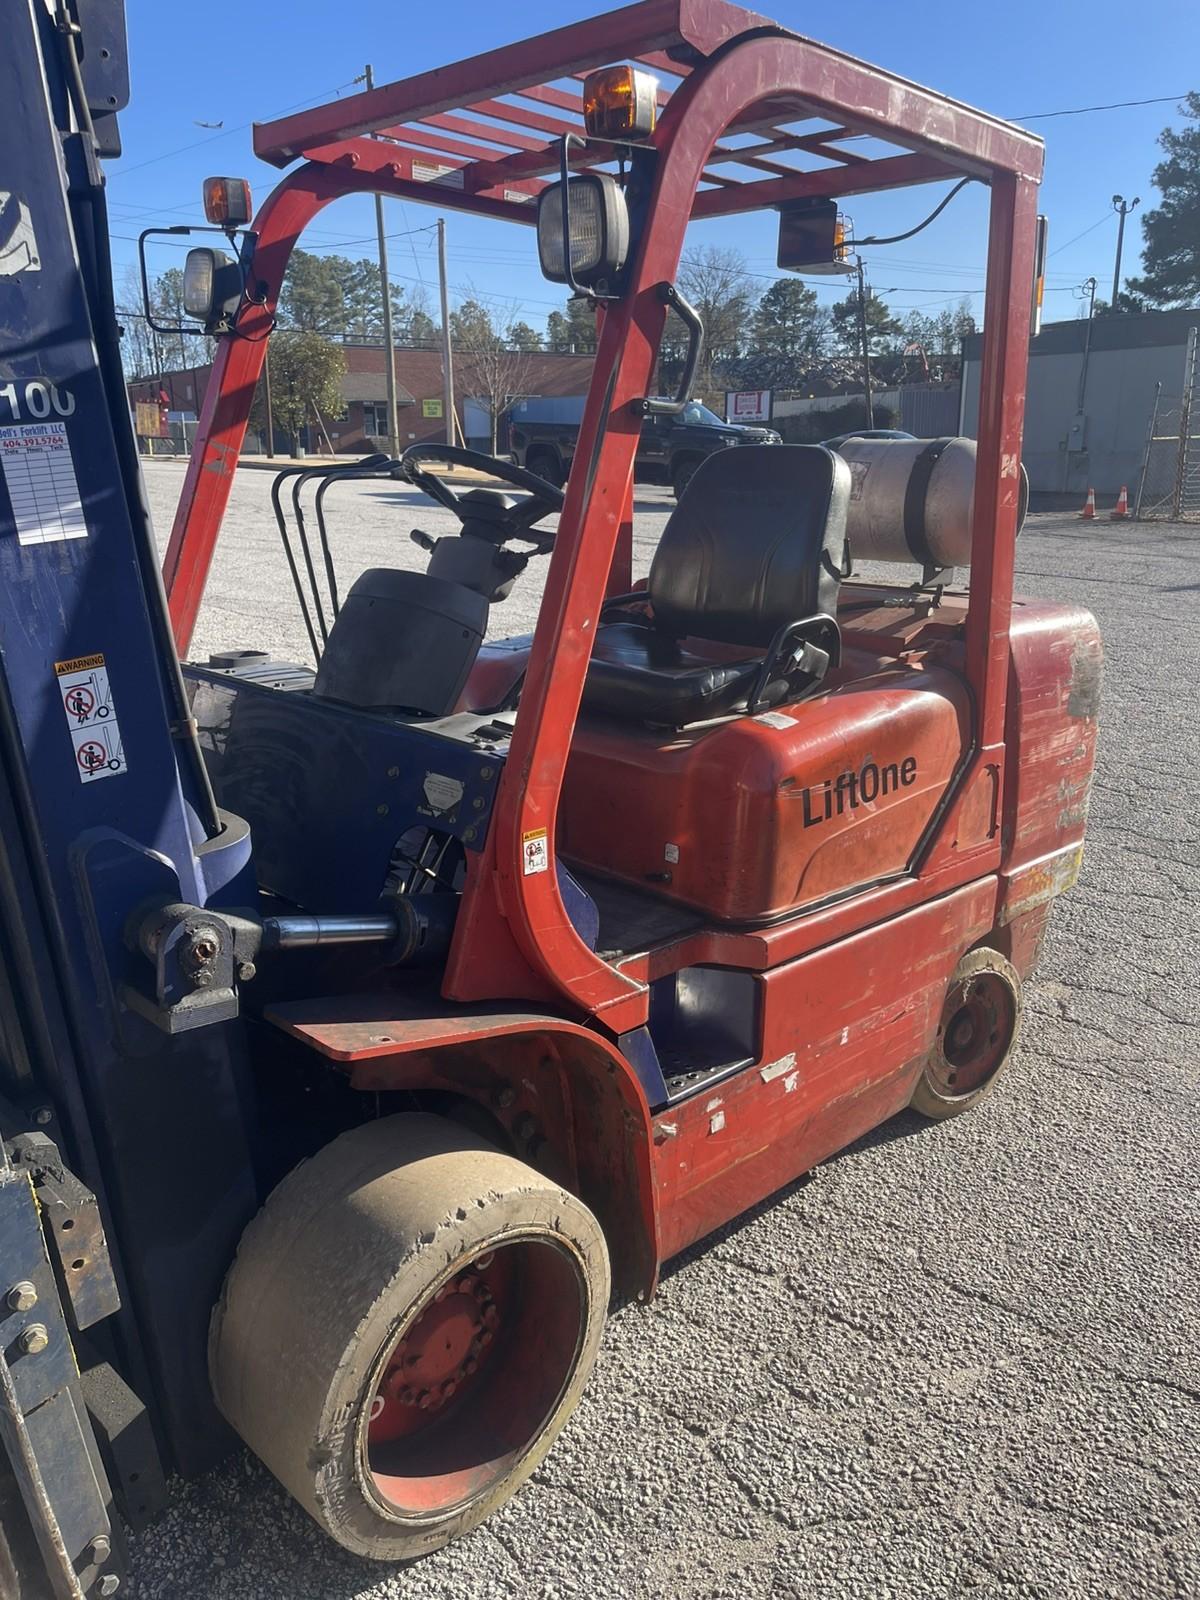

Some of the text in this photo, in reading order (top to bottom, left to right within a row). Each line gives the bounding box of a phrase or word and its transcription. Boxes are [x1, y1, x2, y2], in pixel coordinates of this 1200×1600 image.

[20, 425, 47, 437] Forklift
[50, 424, 65, 433] LLC
[64, 655, 104, 671] WARNING
[802, 756, 917, 829] LiftOne
